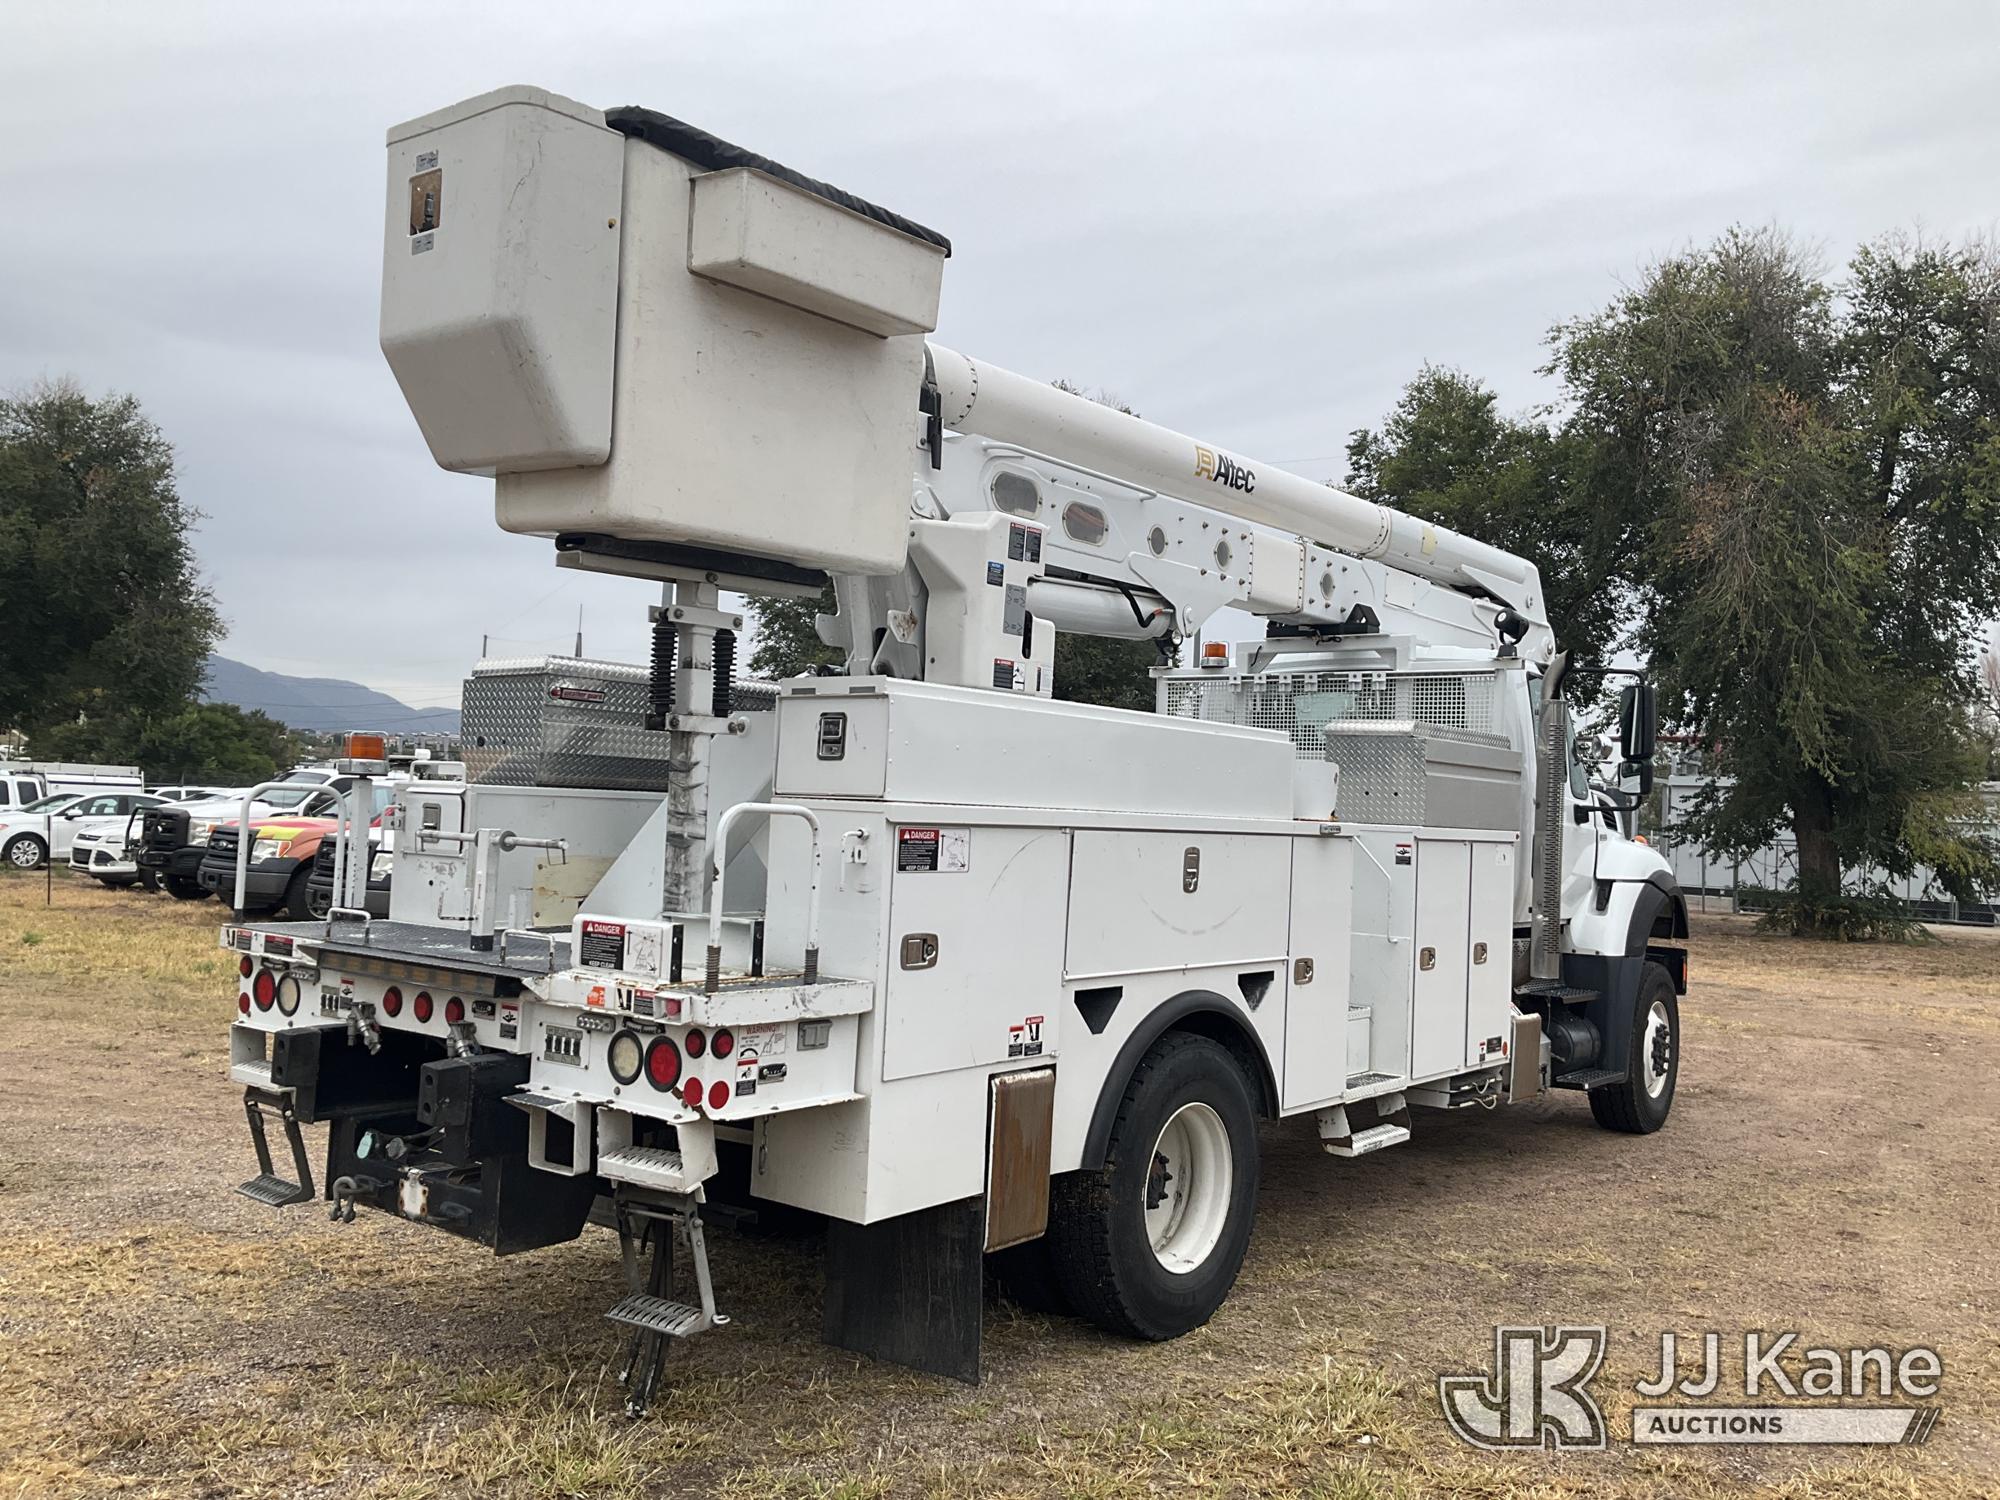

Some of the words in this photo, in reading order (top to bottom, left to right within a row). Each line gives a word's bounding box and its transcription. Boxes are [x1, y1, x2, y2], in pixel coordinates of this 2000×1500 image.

[1213, 454, 1256, 494] Altec
[910, 831, 935, 840] DANGER
[594, 923, 621, 935] DANGER
